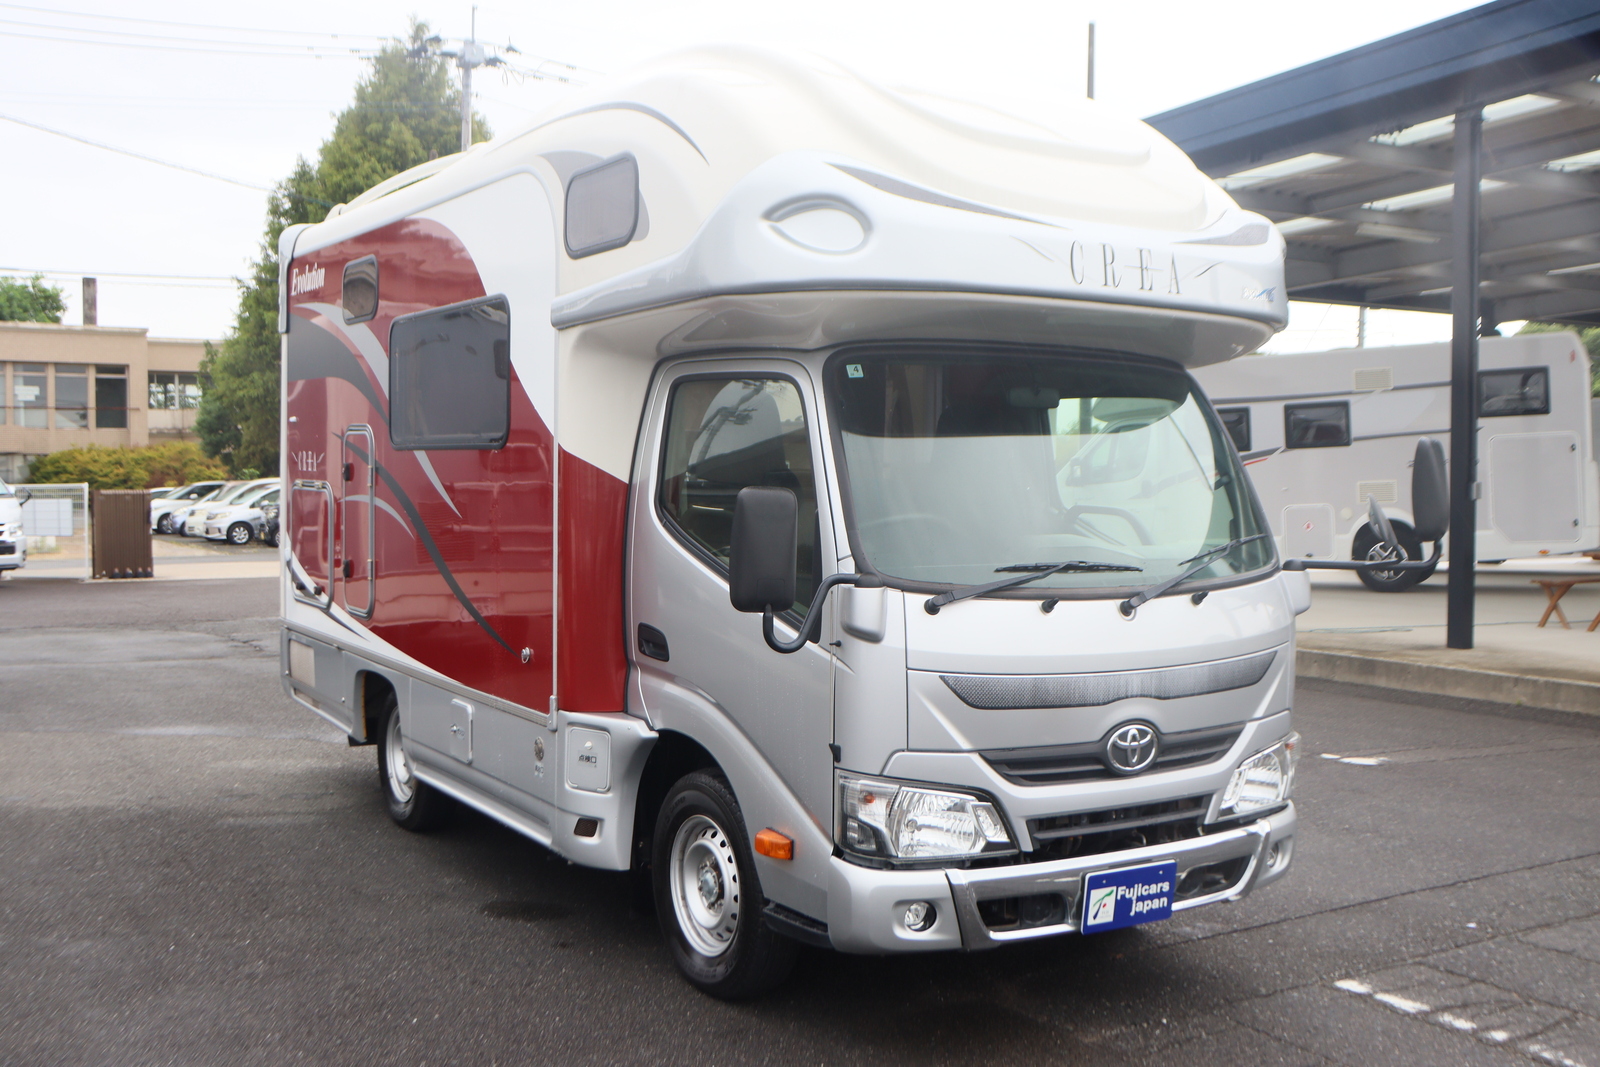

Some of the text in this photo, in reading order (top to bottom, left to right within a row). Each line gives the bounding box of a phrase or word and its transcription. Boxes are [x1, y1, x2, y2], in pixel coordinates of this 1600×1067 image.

[290, 262, 325, 296] Evolution
[1070, 239, 1181, 294] CREA
[578, 754, 597, 764] 点検口
[1117, 881, 1170, 900] Fujicars
